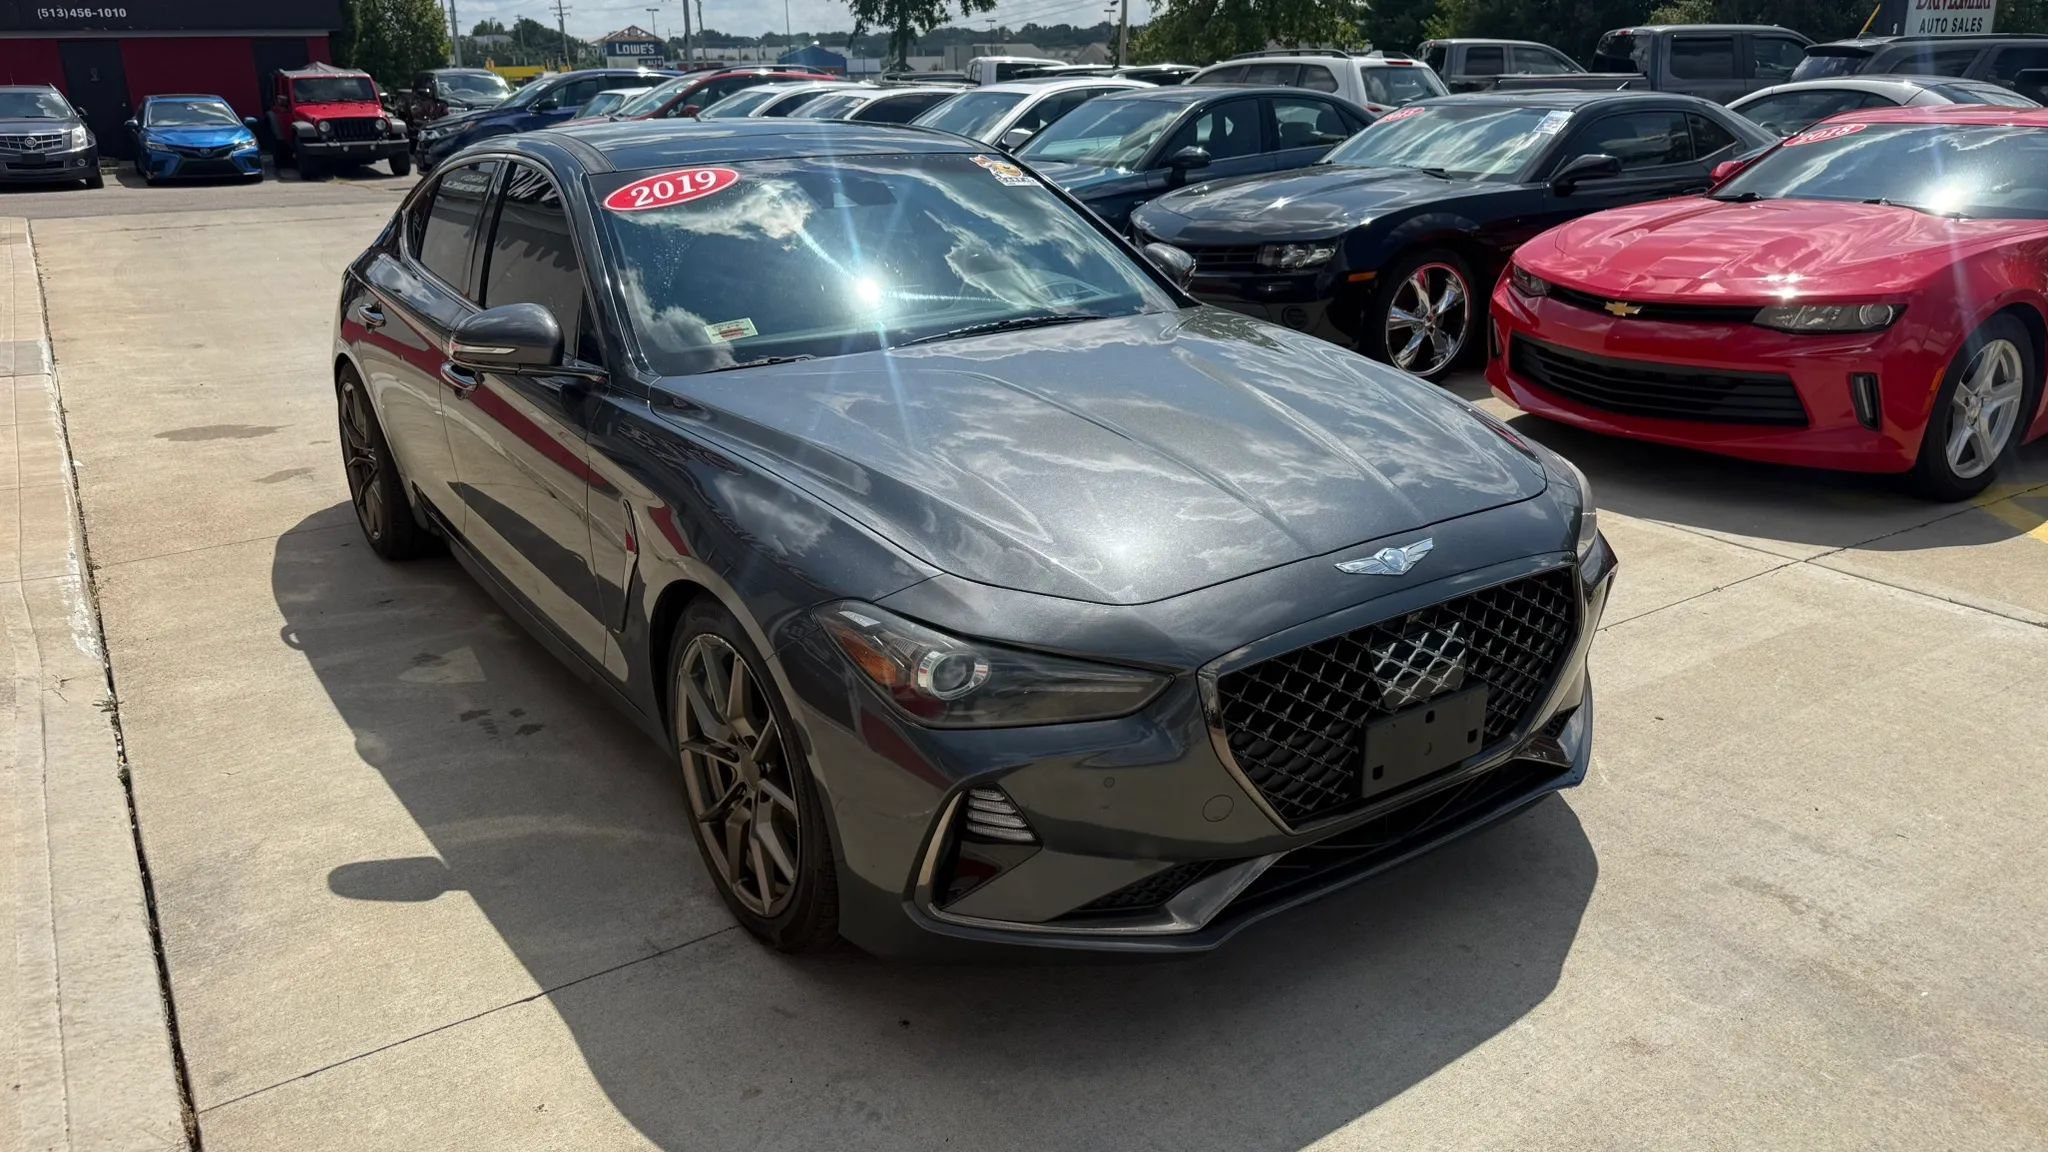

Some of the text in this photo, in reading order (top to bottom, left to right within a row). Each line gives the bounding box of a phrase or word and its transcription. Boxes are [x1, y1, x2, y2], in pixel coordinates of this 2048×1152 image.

[1919, 16, 1983, 34] AUTO SALES
[615, 42, 656, 55] LOWE'S
[630, 170, 717, 207] 2019
